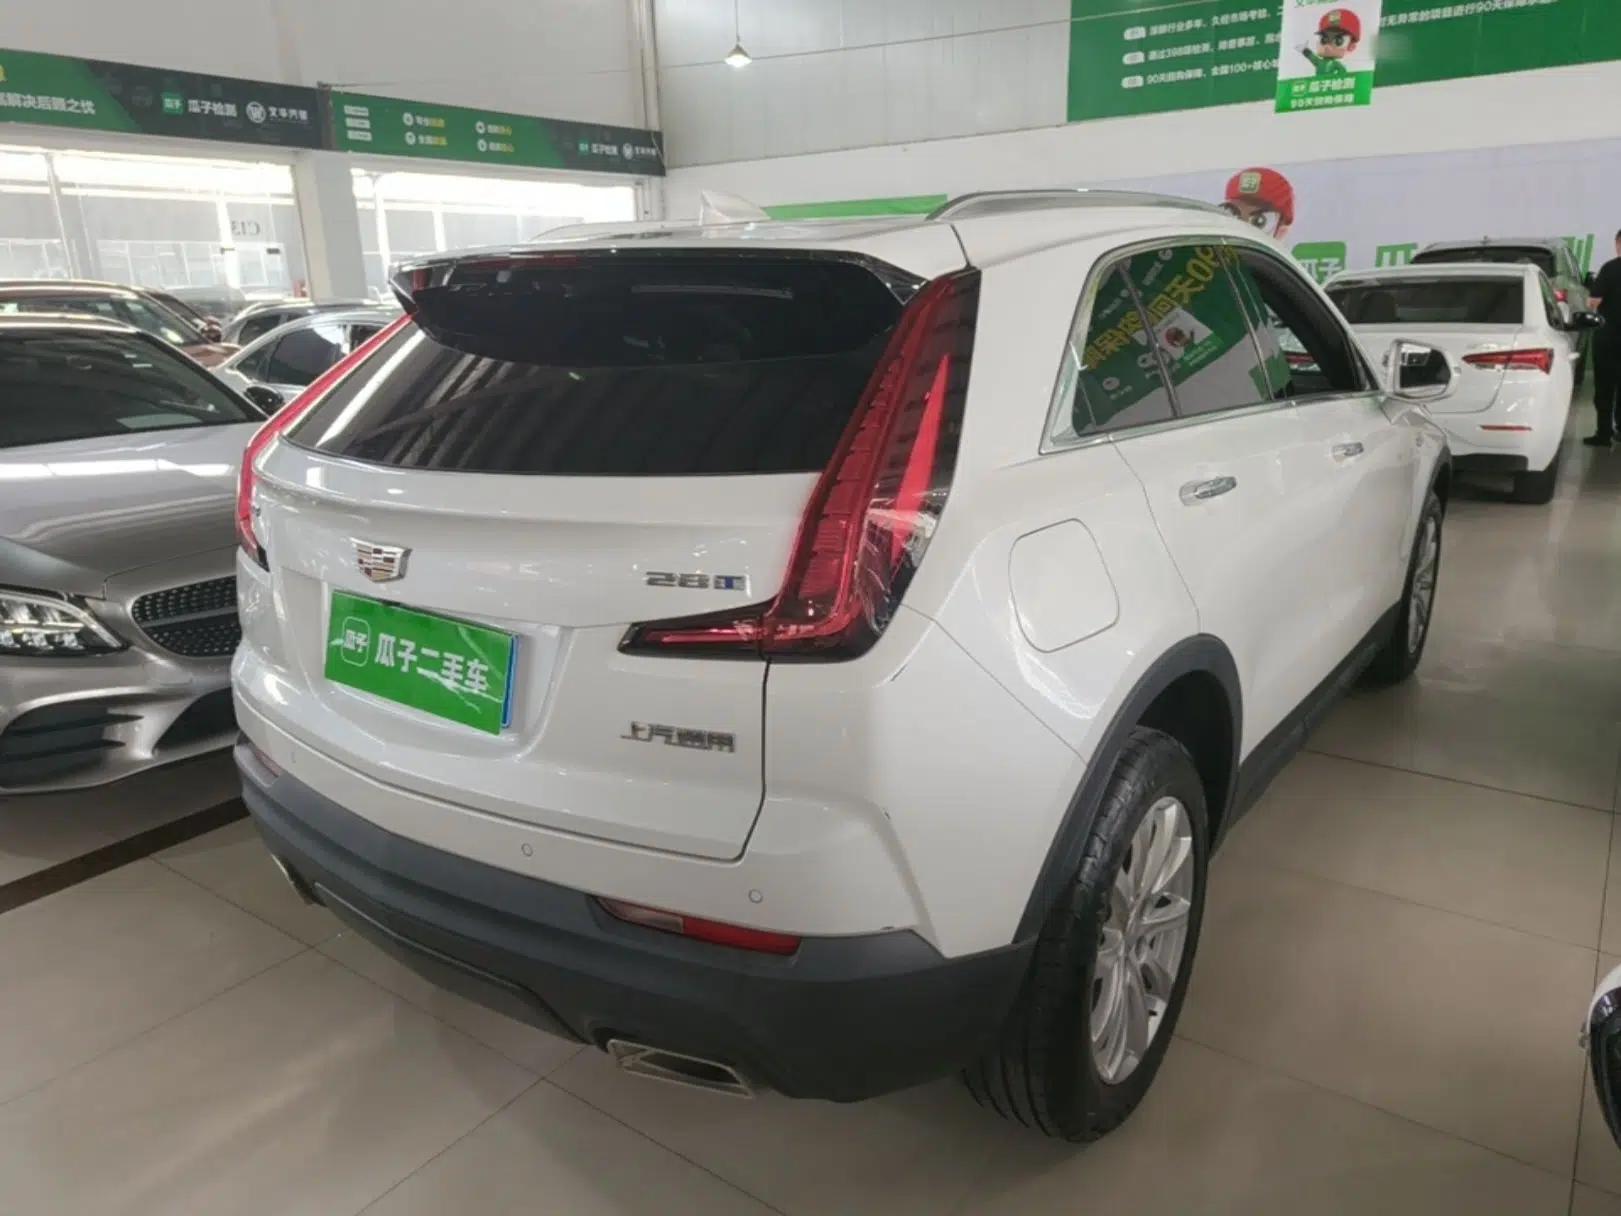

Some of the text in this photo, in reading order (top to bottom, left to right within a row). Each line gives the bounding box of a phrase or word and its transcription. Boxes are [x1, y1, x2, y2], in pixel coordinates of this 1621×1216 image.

[375, 632, 490, 693] 瓜子二手车
